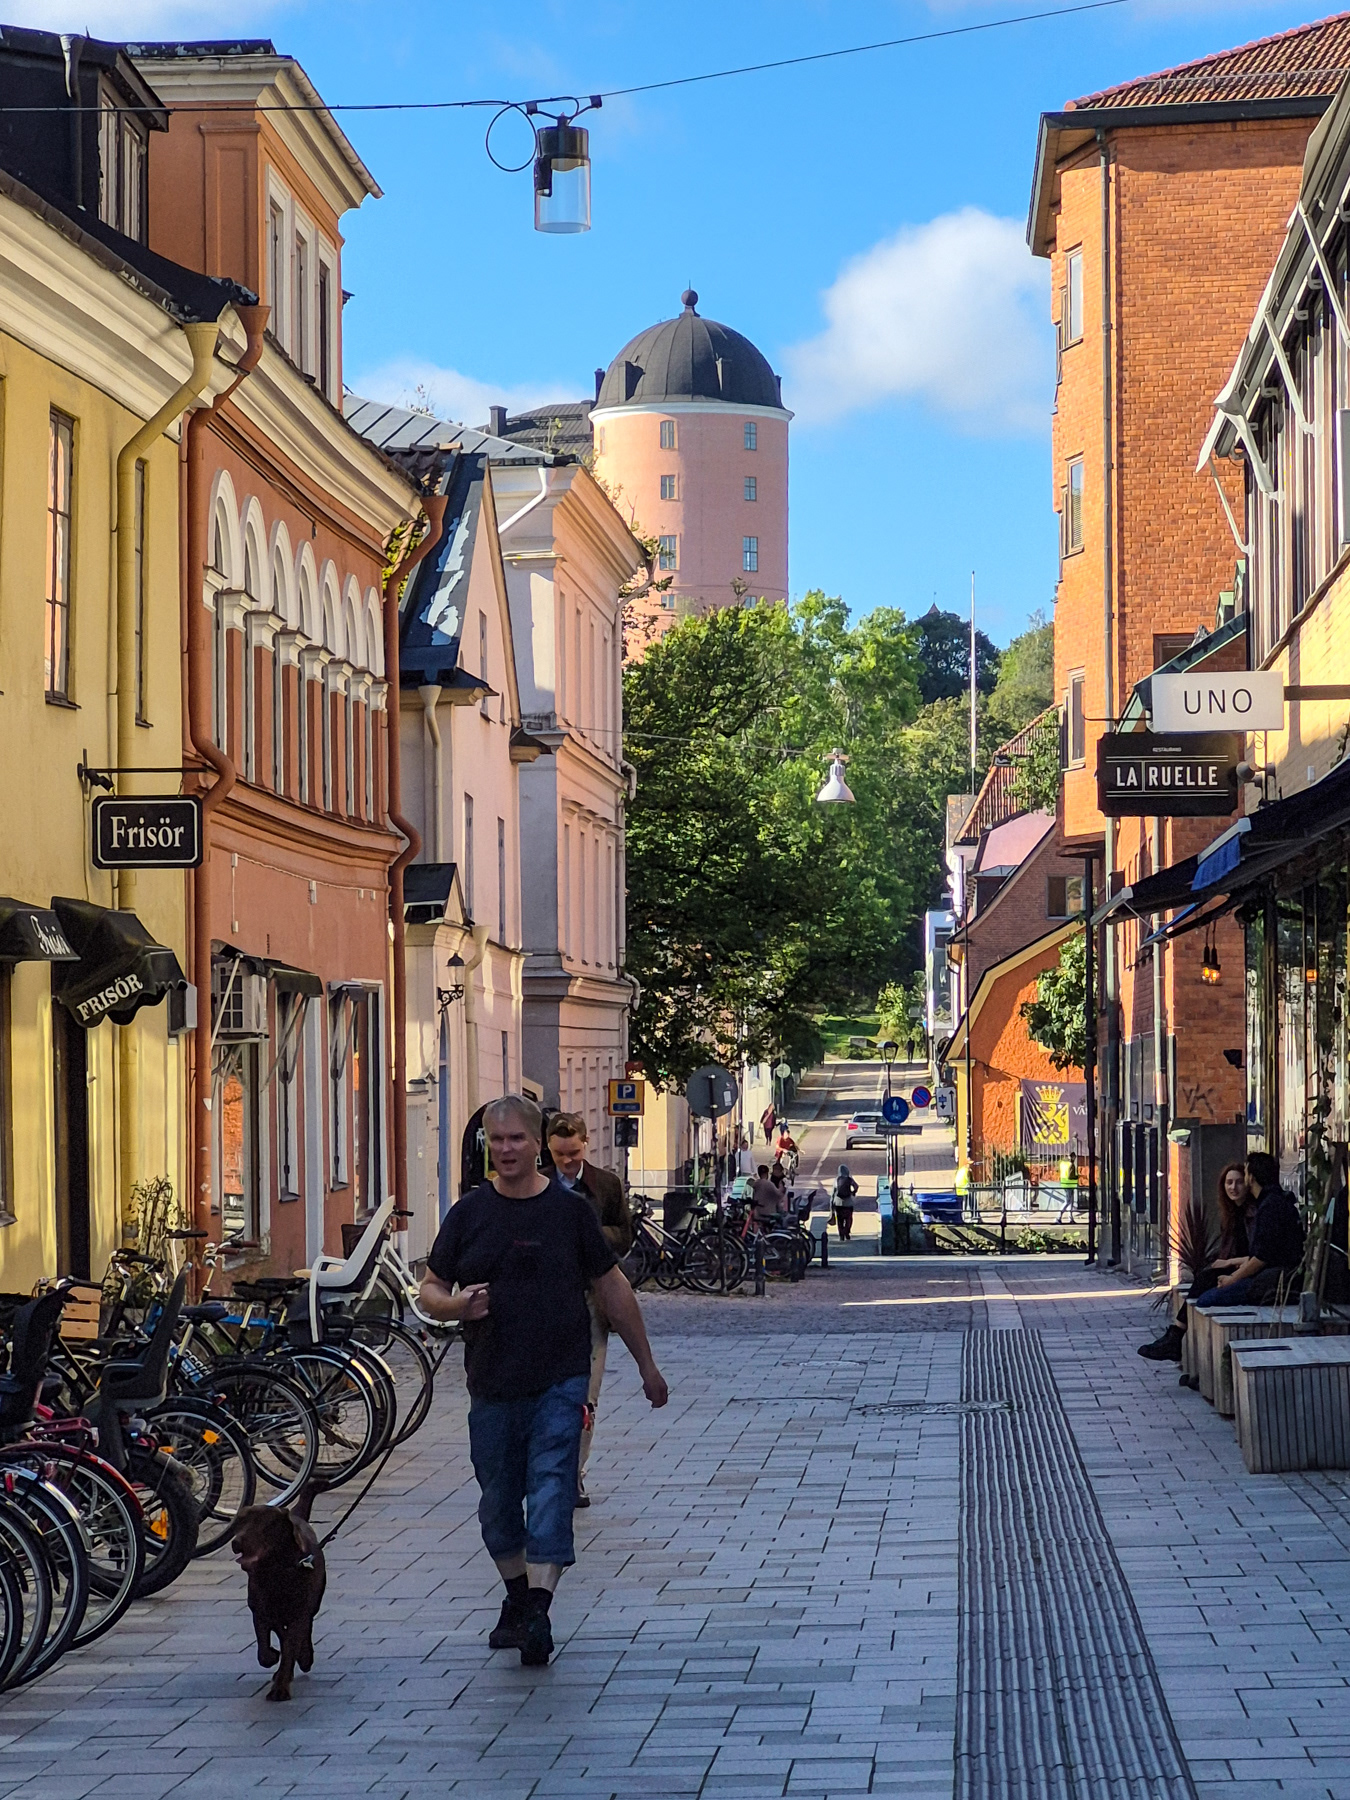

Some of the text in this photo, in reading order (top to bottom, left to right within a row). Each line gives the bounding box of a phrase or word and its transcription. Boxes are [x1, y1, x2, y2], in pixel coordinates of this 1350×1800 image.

[1183, 687, 1253, 715] UNO
[1116, 765, 1218, 787] LA RUELLE
[110, 816, 185, 848] Frisör
[76, 973, 144, 1022] FRISÖR
[622, 1085, 633, 1099] P
